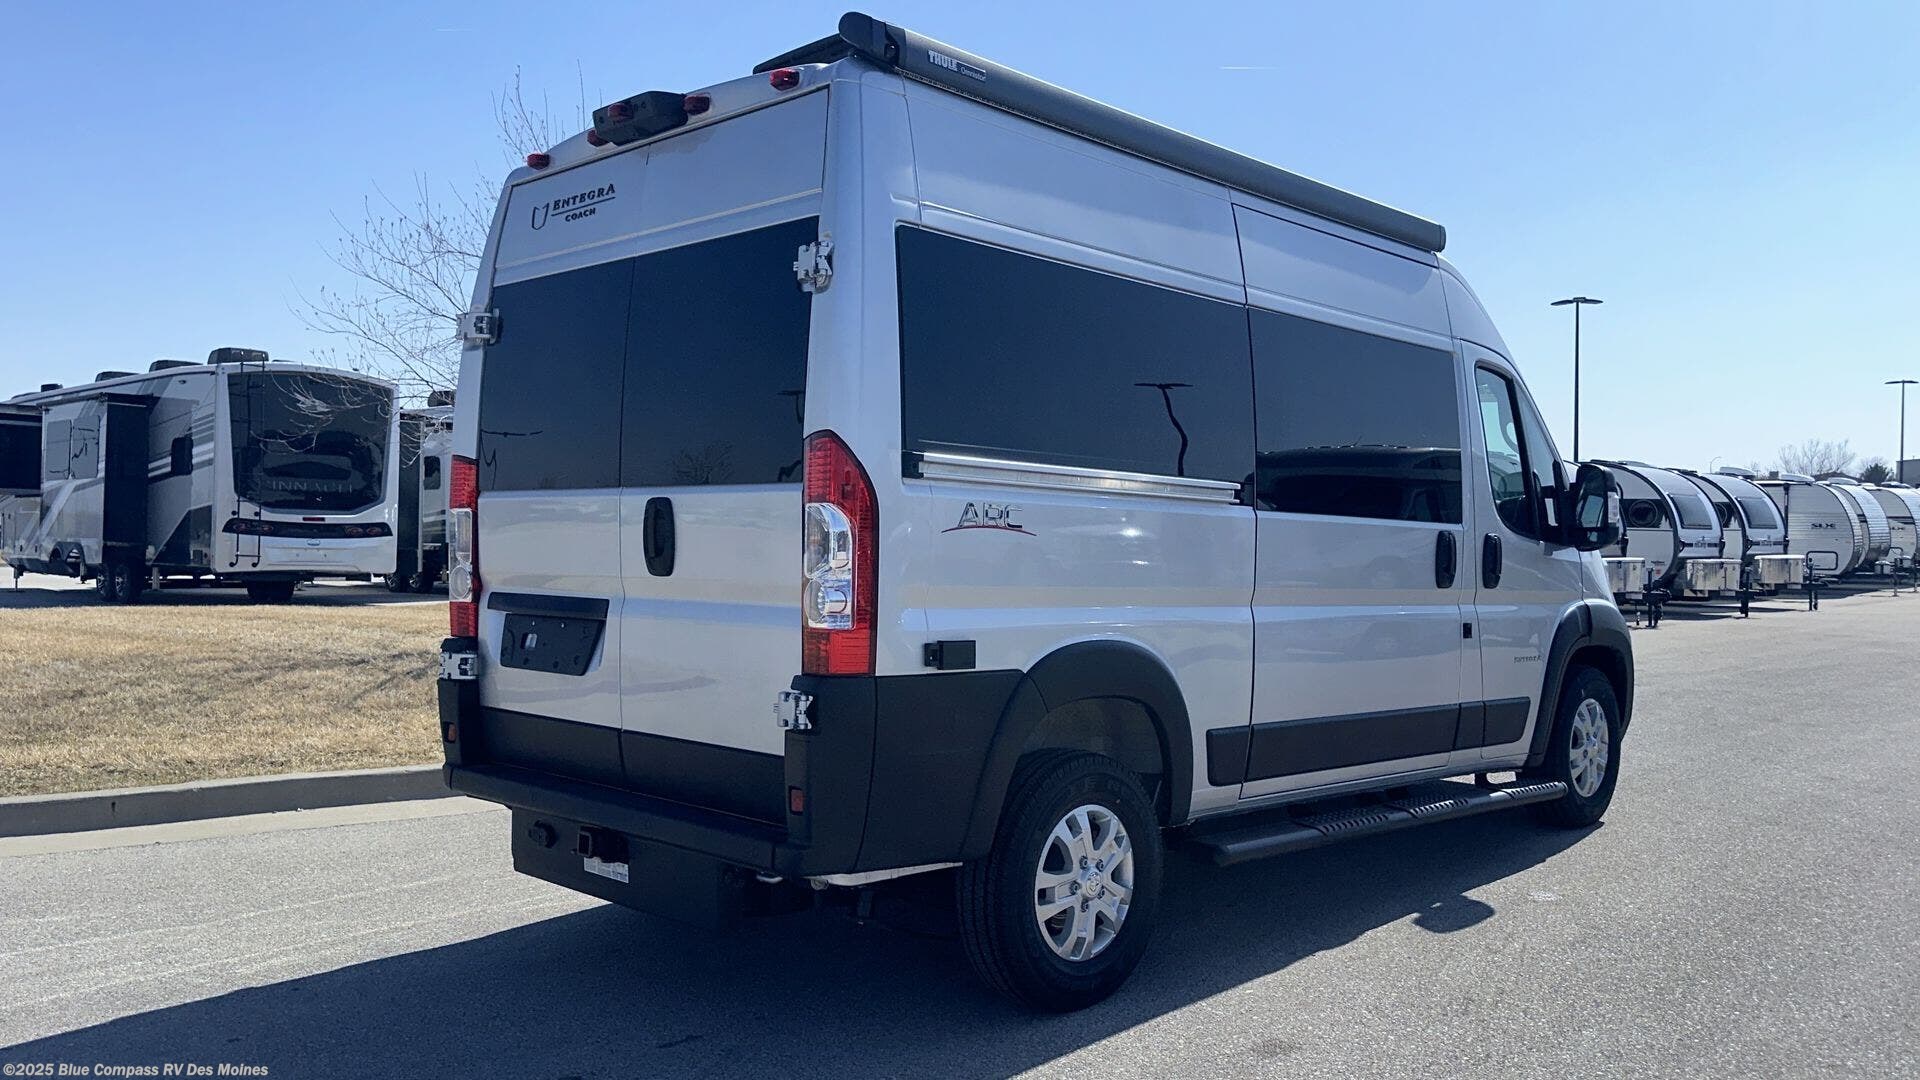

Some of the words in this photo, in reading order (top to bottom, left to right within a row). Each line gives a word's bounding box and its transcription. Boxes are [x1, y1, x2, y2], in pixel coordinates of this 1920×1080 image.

[927, 49, 958, 72] THULE
[552, 183, 616, 211] ENTEGRA
[565, 207, 597, 222] COACH
[958, 502, 1023, 529] ARC
